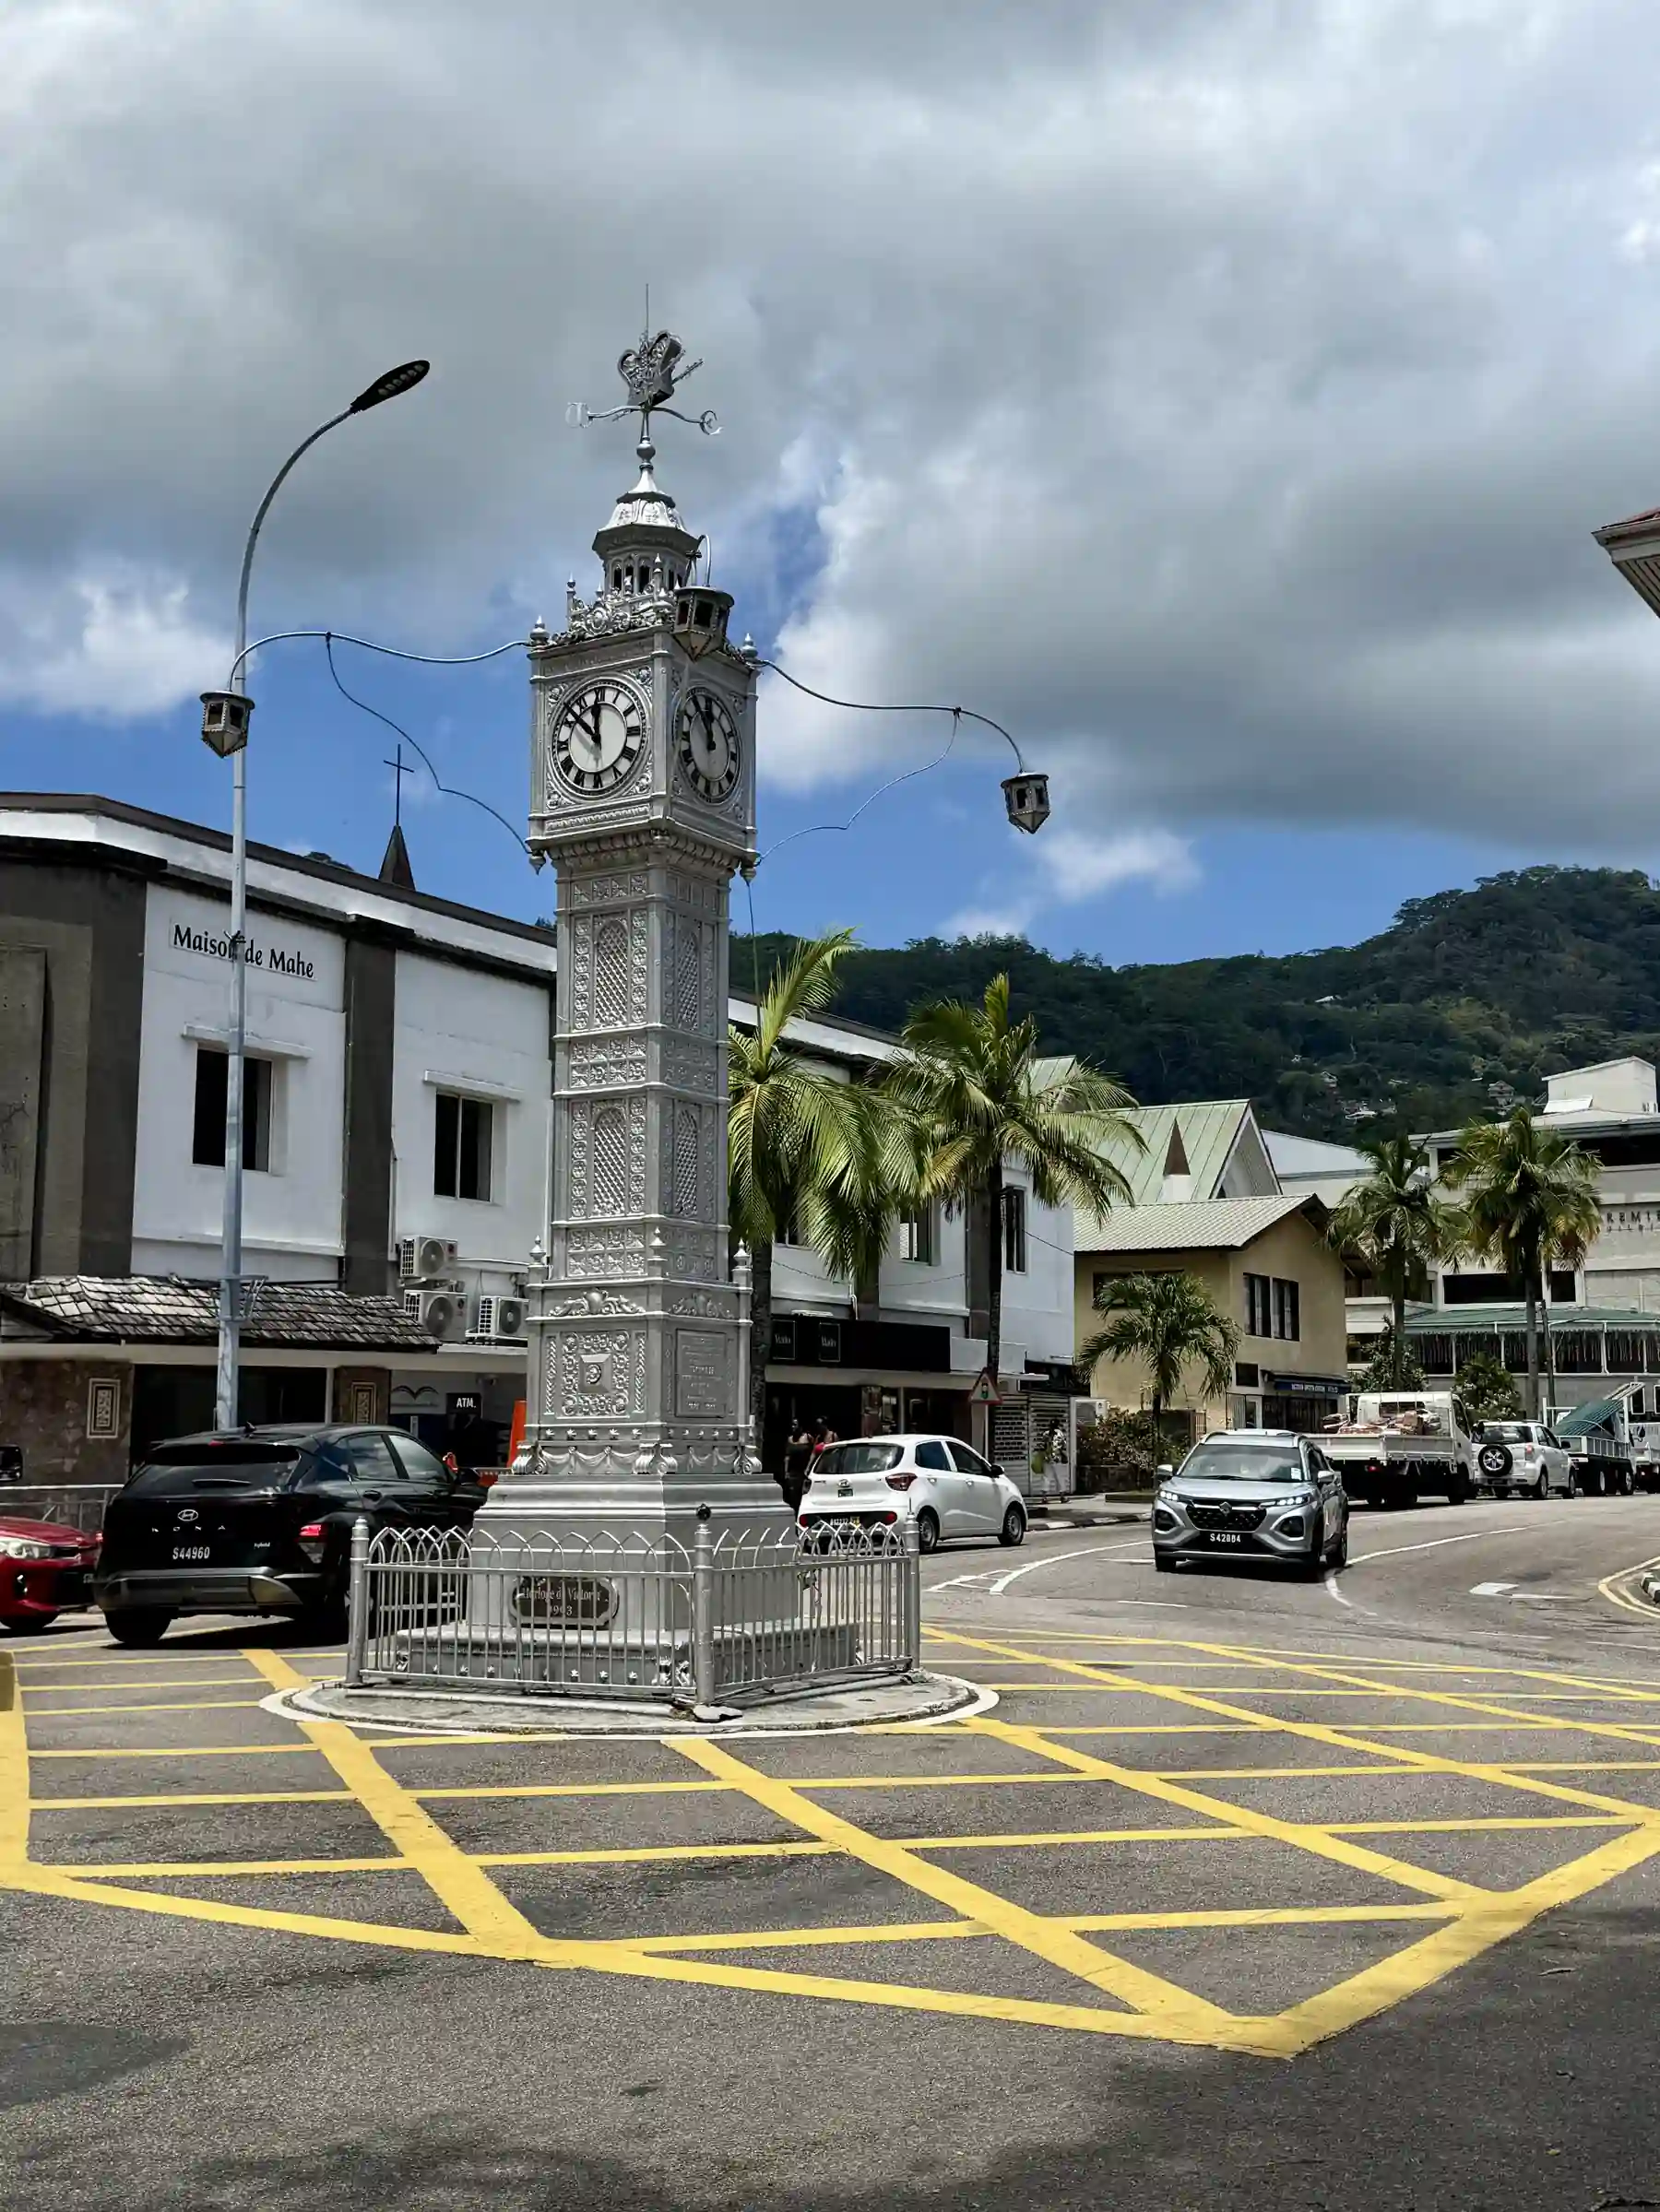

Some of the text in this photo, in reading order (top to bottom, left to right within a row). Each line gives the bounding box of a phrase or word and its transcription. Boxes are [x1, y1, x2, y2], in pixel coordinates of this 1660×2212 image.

[245, 939, 263, 965] de
[269, 948, 314, 978] Mahe
[172, 1546, 210, 1560] S44960
